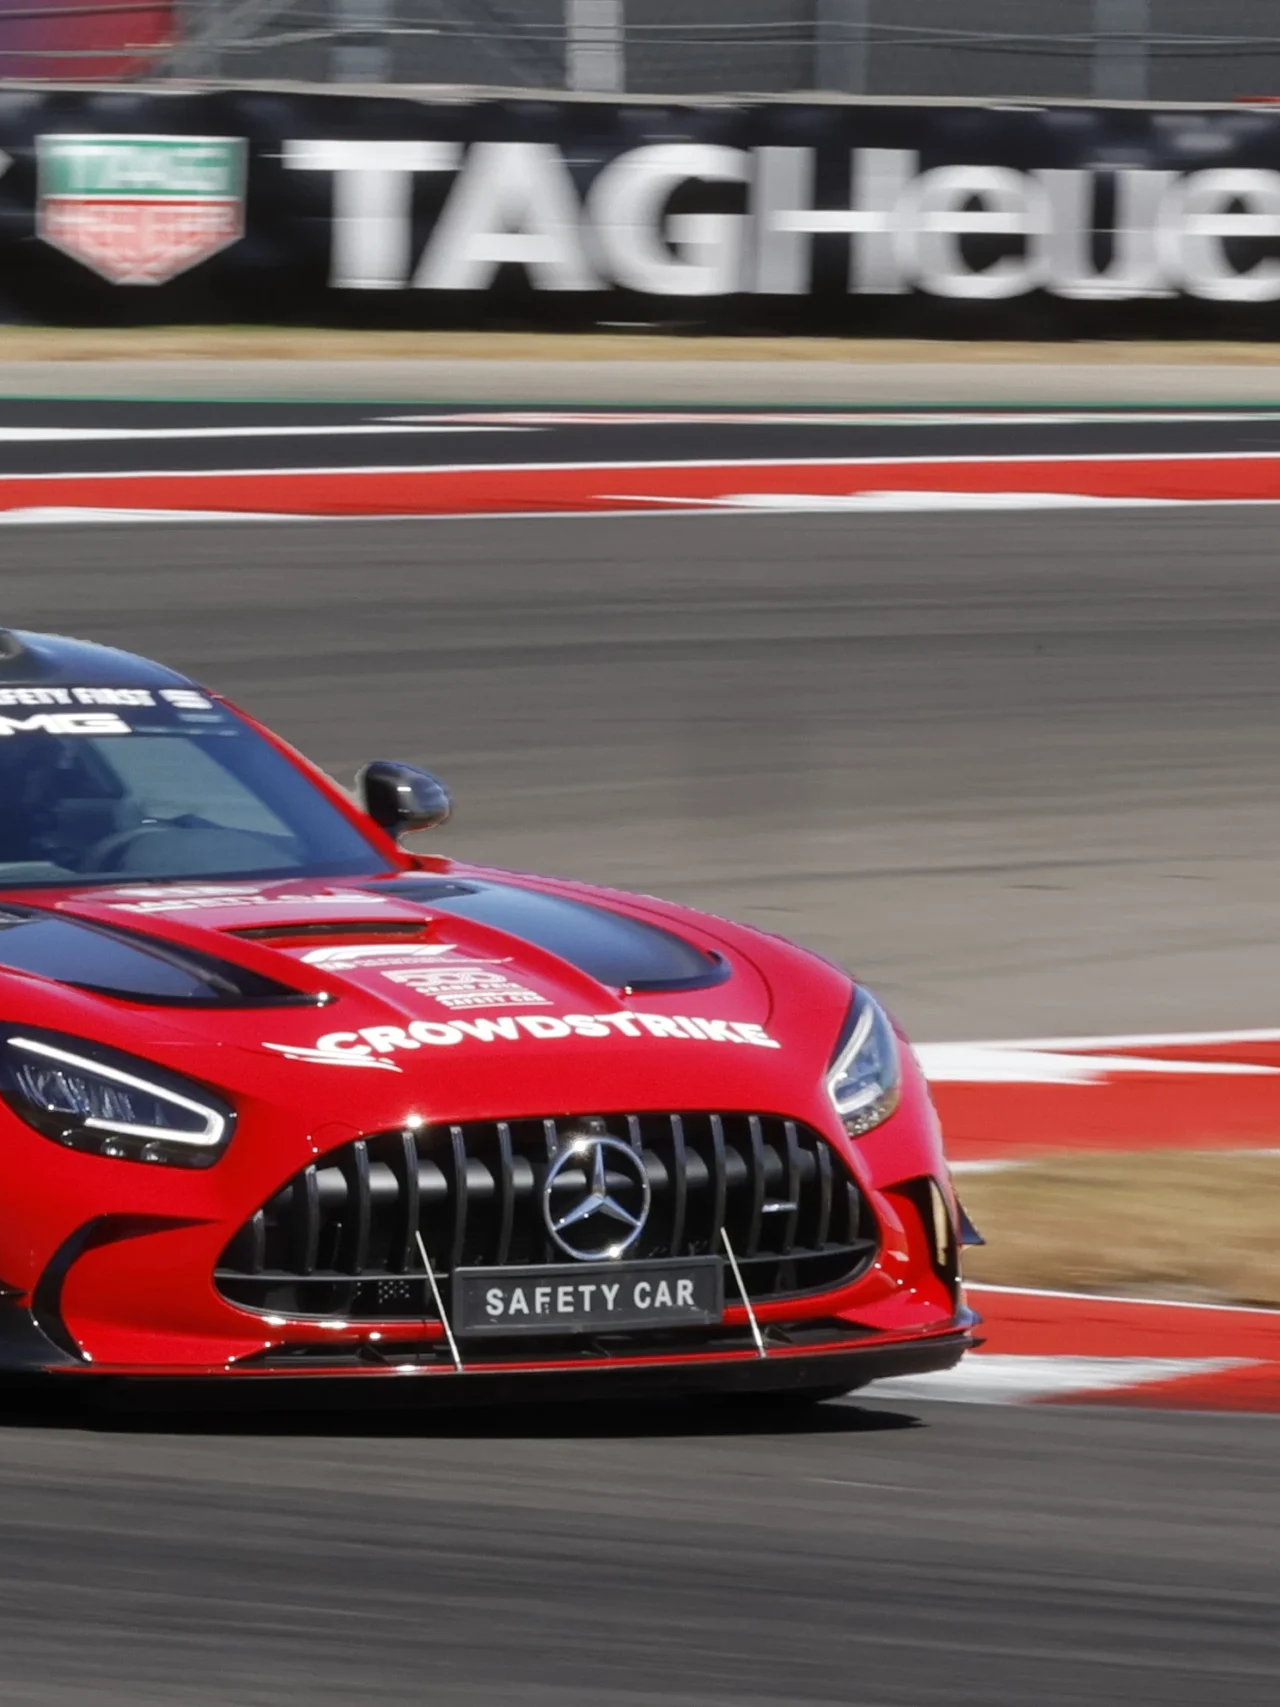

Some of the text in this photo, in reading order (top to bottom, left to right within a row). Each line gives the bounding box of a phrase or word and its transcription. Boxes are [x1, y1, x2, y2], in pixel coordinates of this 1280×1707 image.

[71, 688, 157, 706] FIRST
[317, 1011, 781, 1058] CROWDSTRIKE
[485, 1279, 695, 1316] SAFETY CAR
